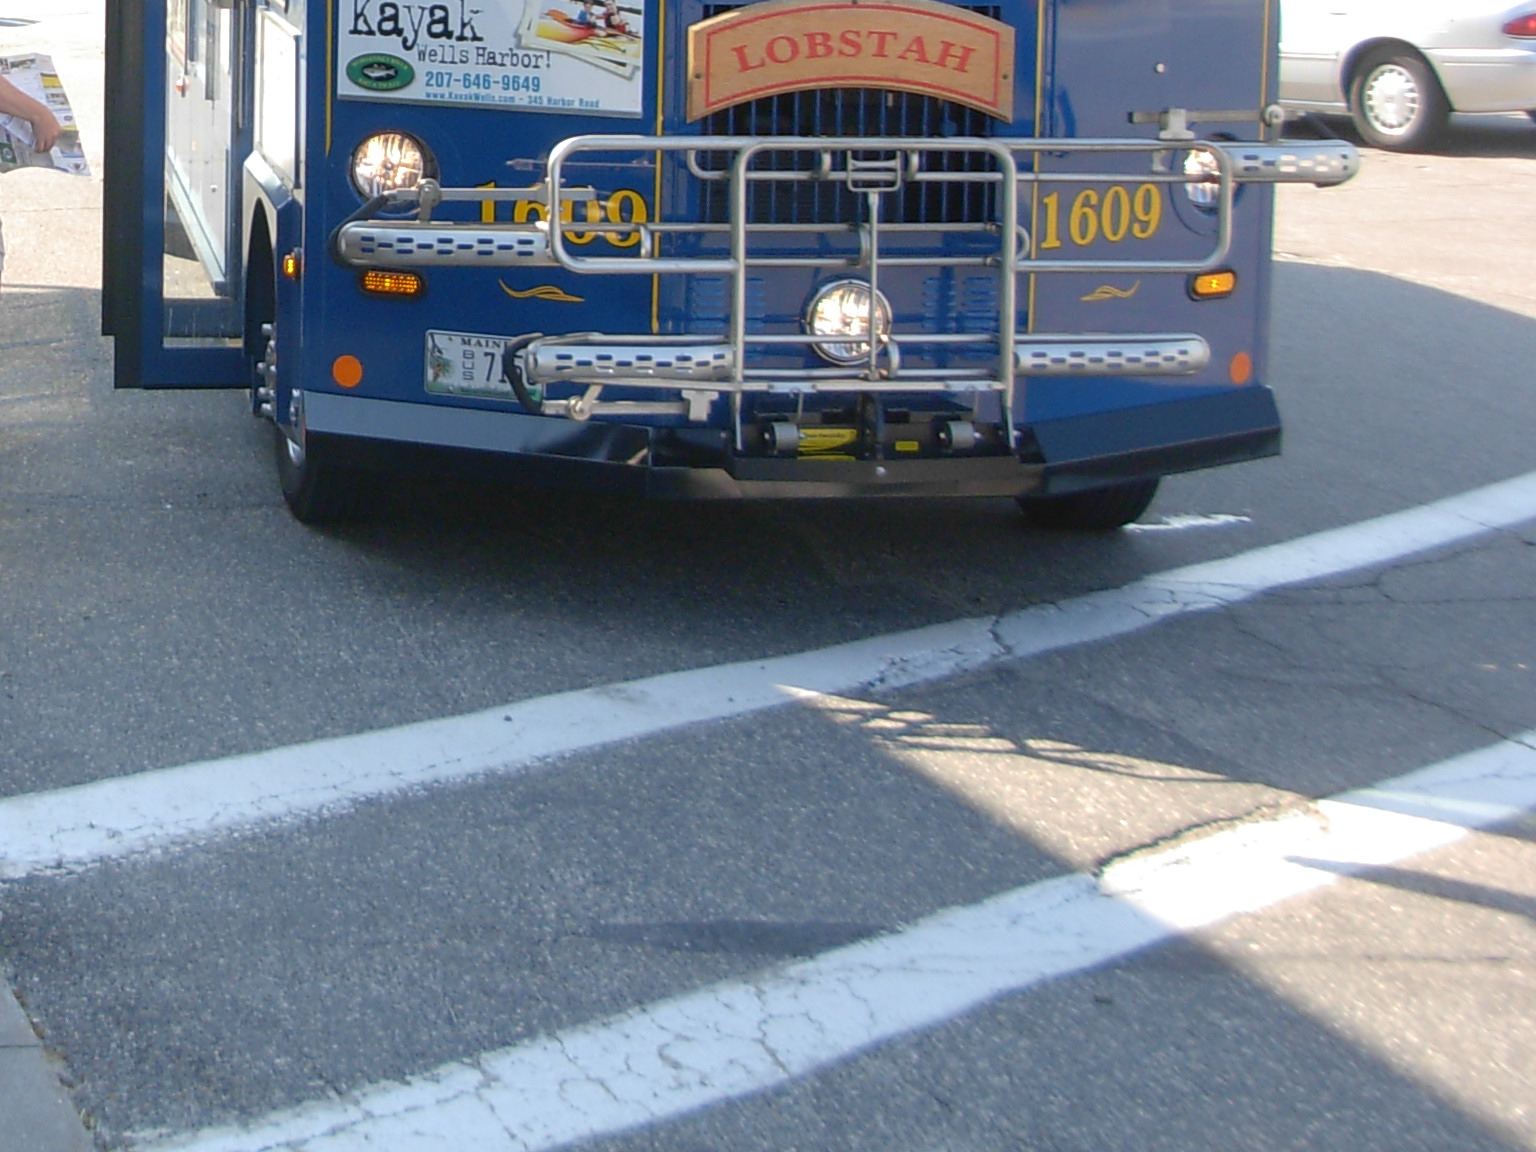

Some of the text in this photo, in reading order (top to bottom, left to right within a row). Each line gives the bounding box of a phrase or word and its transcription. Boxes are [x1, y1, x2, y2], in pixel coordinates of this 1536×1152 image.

[417, 44, 469, 65] Wells
[475, 48, 552, 70] Harbor!
[731, 30, 976, 73] LOBSTAH
[425, 70, 542, 93] 207-646-9649
[1039, 182, 1163, 249] 1609
